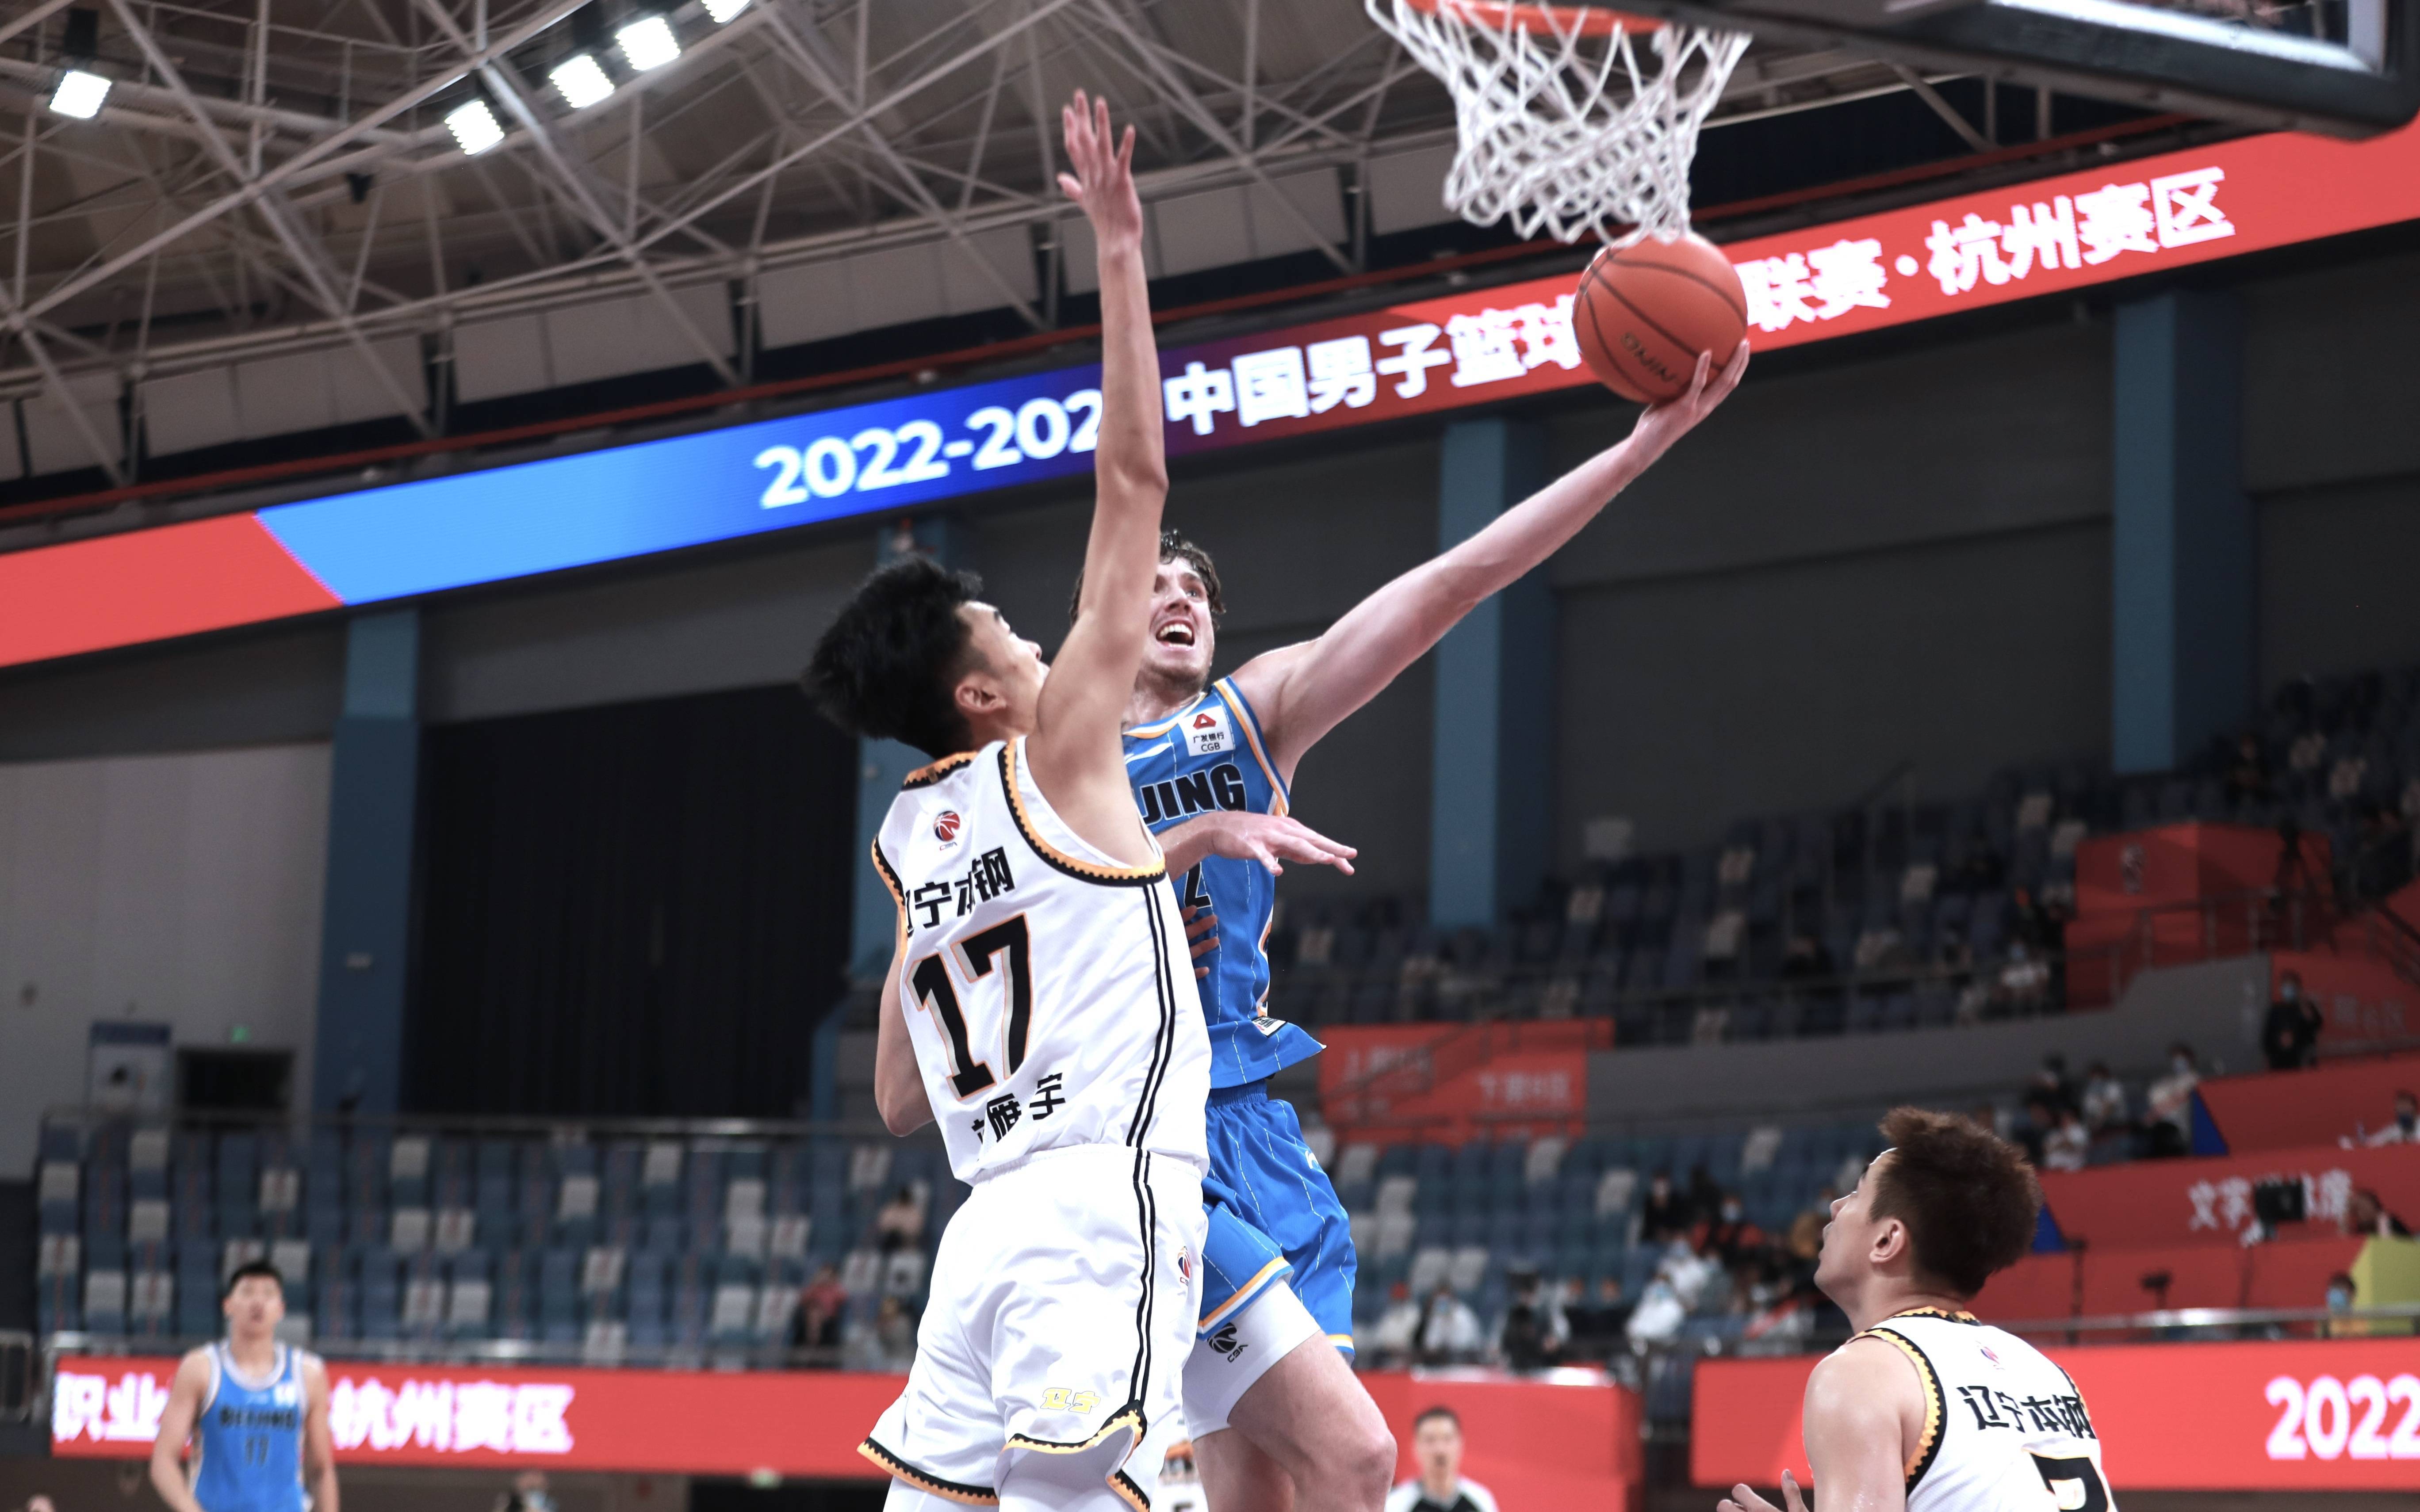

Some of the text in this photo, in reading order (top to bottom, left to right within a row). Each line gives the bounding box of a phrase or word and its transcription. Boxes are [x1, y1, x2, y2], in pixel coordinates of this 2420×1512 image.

[753, 388, 1103, 509] 2022-202
[1193, 732, 1224, 744] 广发银行
[1201, 742, 1221, 752] CGB
[905, 912, 1033, 1101] 17
[1227, 1344, 1248, 1363] CBA
[1956, 1385, 2097, 1439] 辽宁本钢
[2264, 1374, 2420, 1460] 2022
